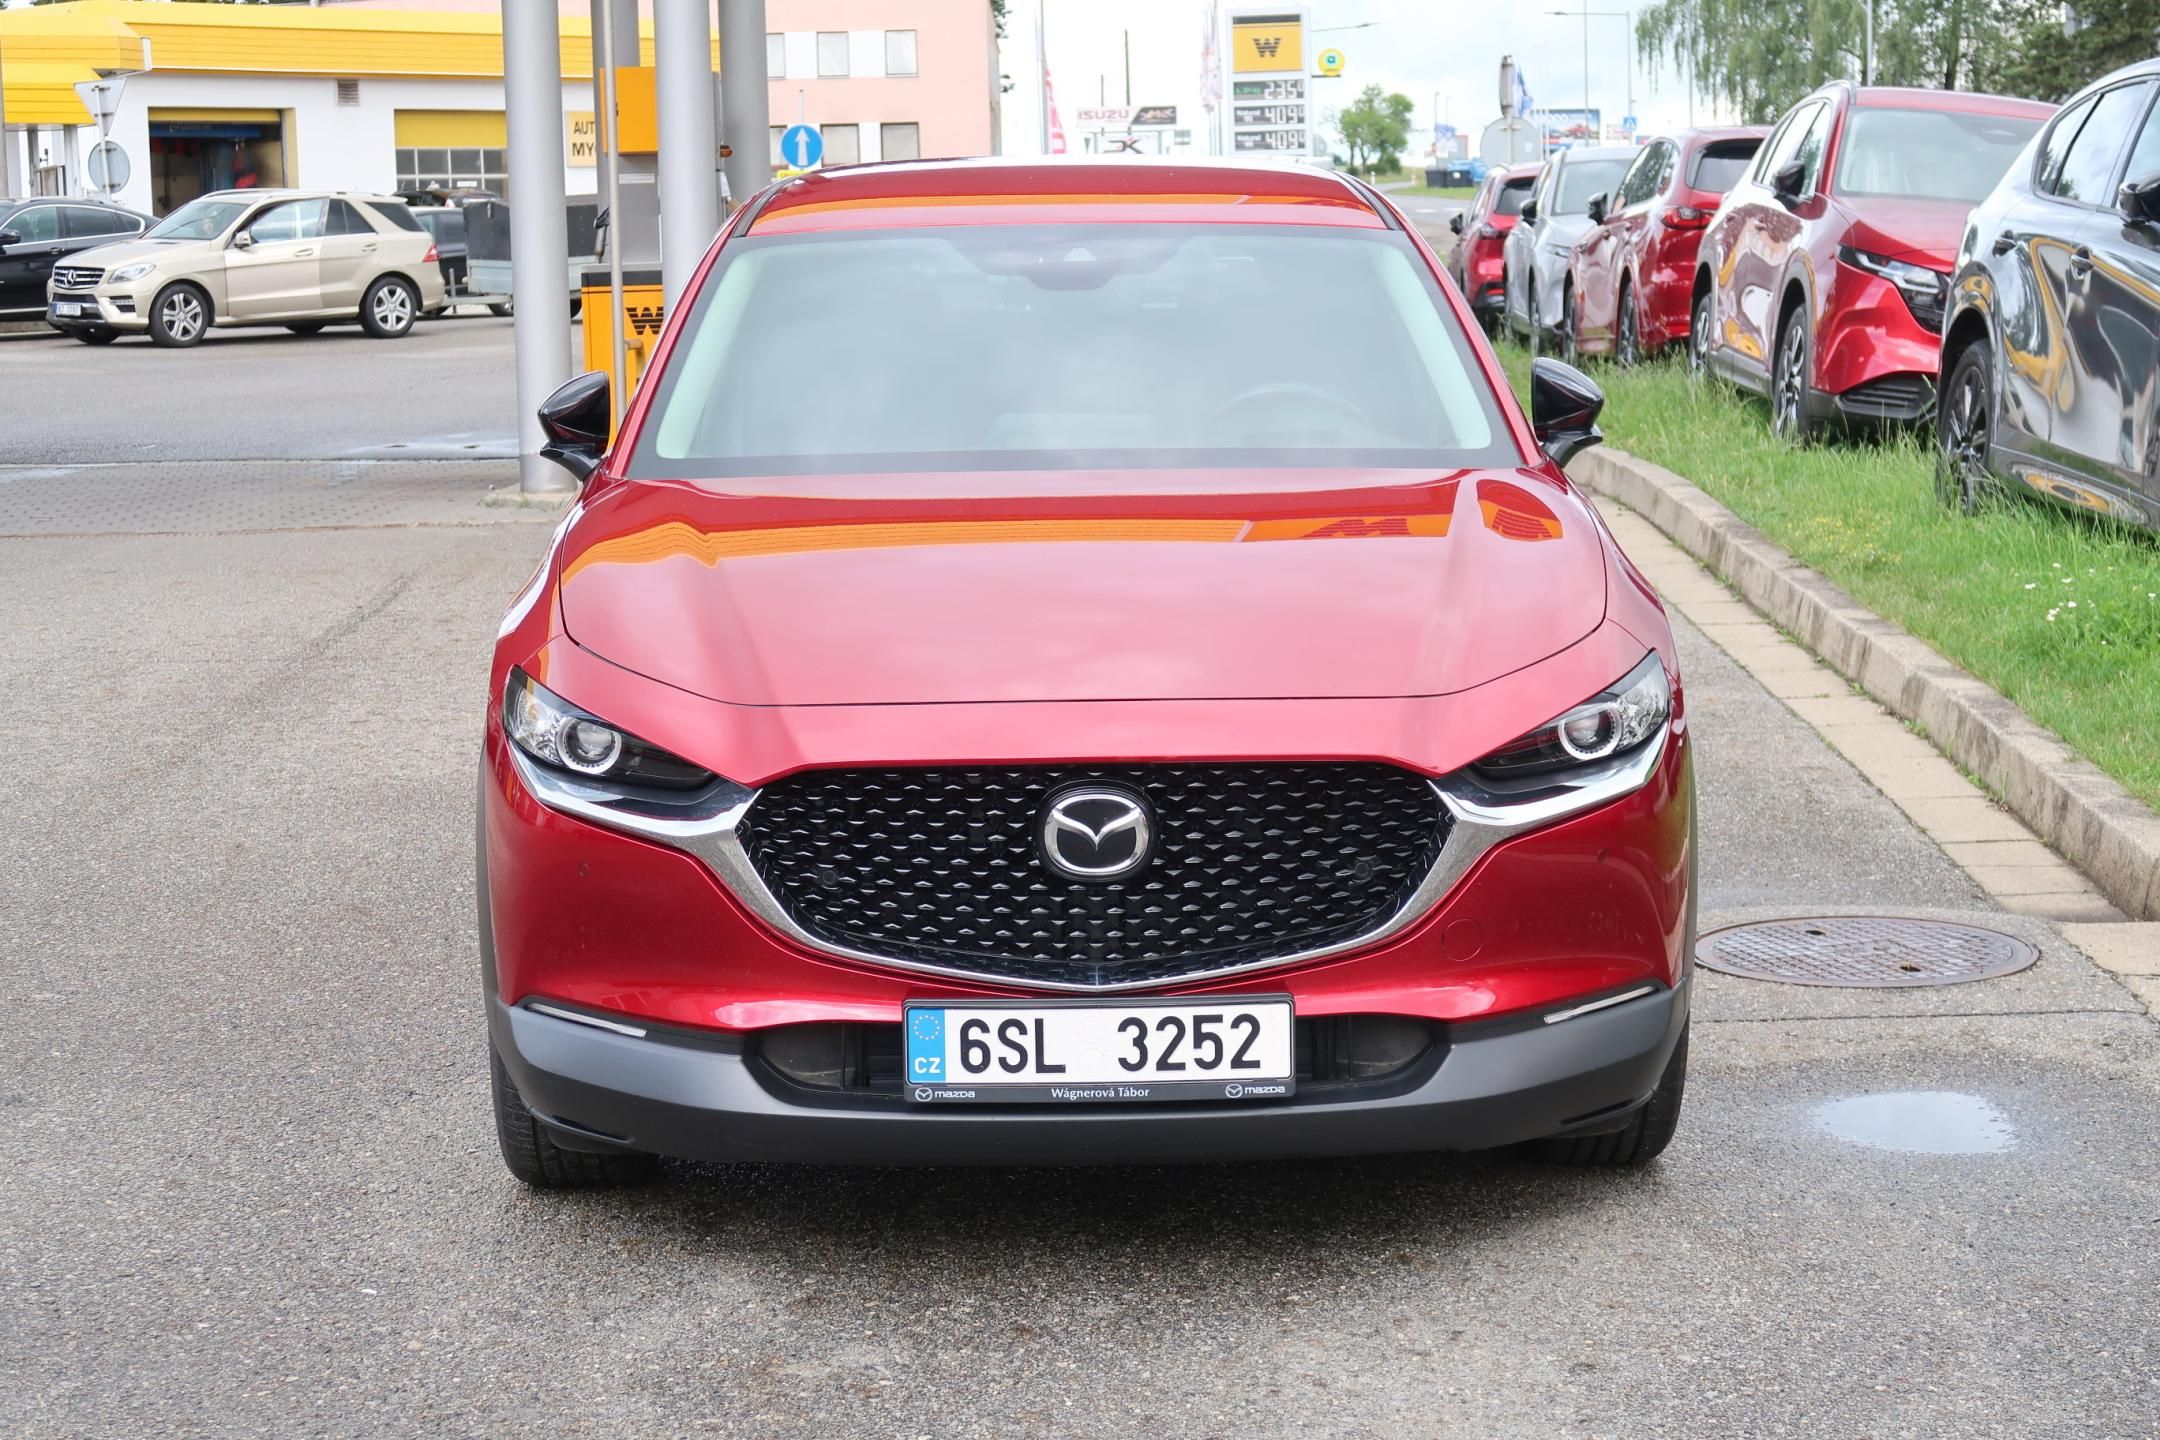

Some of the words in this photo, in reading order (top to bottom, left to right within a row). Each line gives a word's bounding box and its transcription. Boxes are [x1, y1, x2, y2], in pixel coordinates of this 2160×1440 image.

[1078, 110, 1129, 120] ISUZU
[573, 121, 596, 135] AUT
[571, 142, 596, 157] MY
[960, 1018, 1066, 1074] 6SL
[1118, 1013, 1261, 1072] 3252
[914, 1057, 941, 1074] CZ
[1051, 1086, 1114, 1100] Wágnerová
[1118, 1085, 1150, 1098] Tábor
